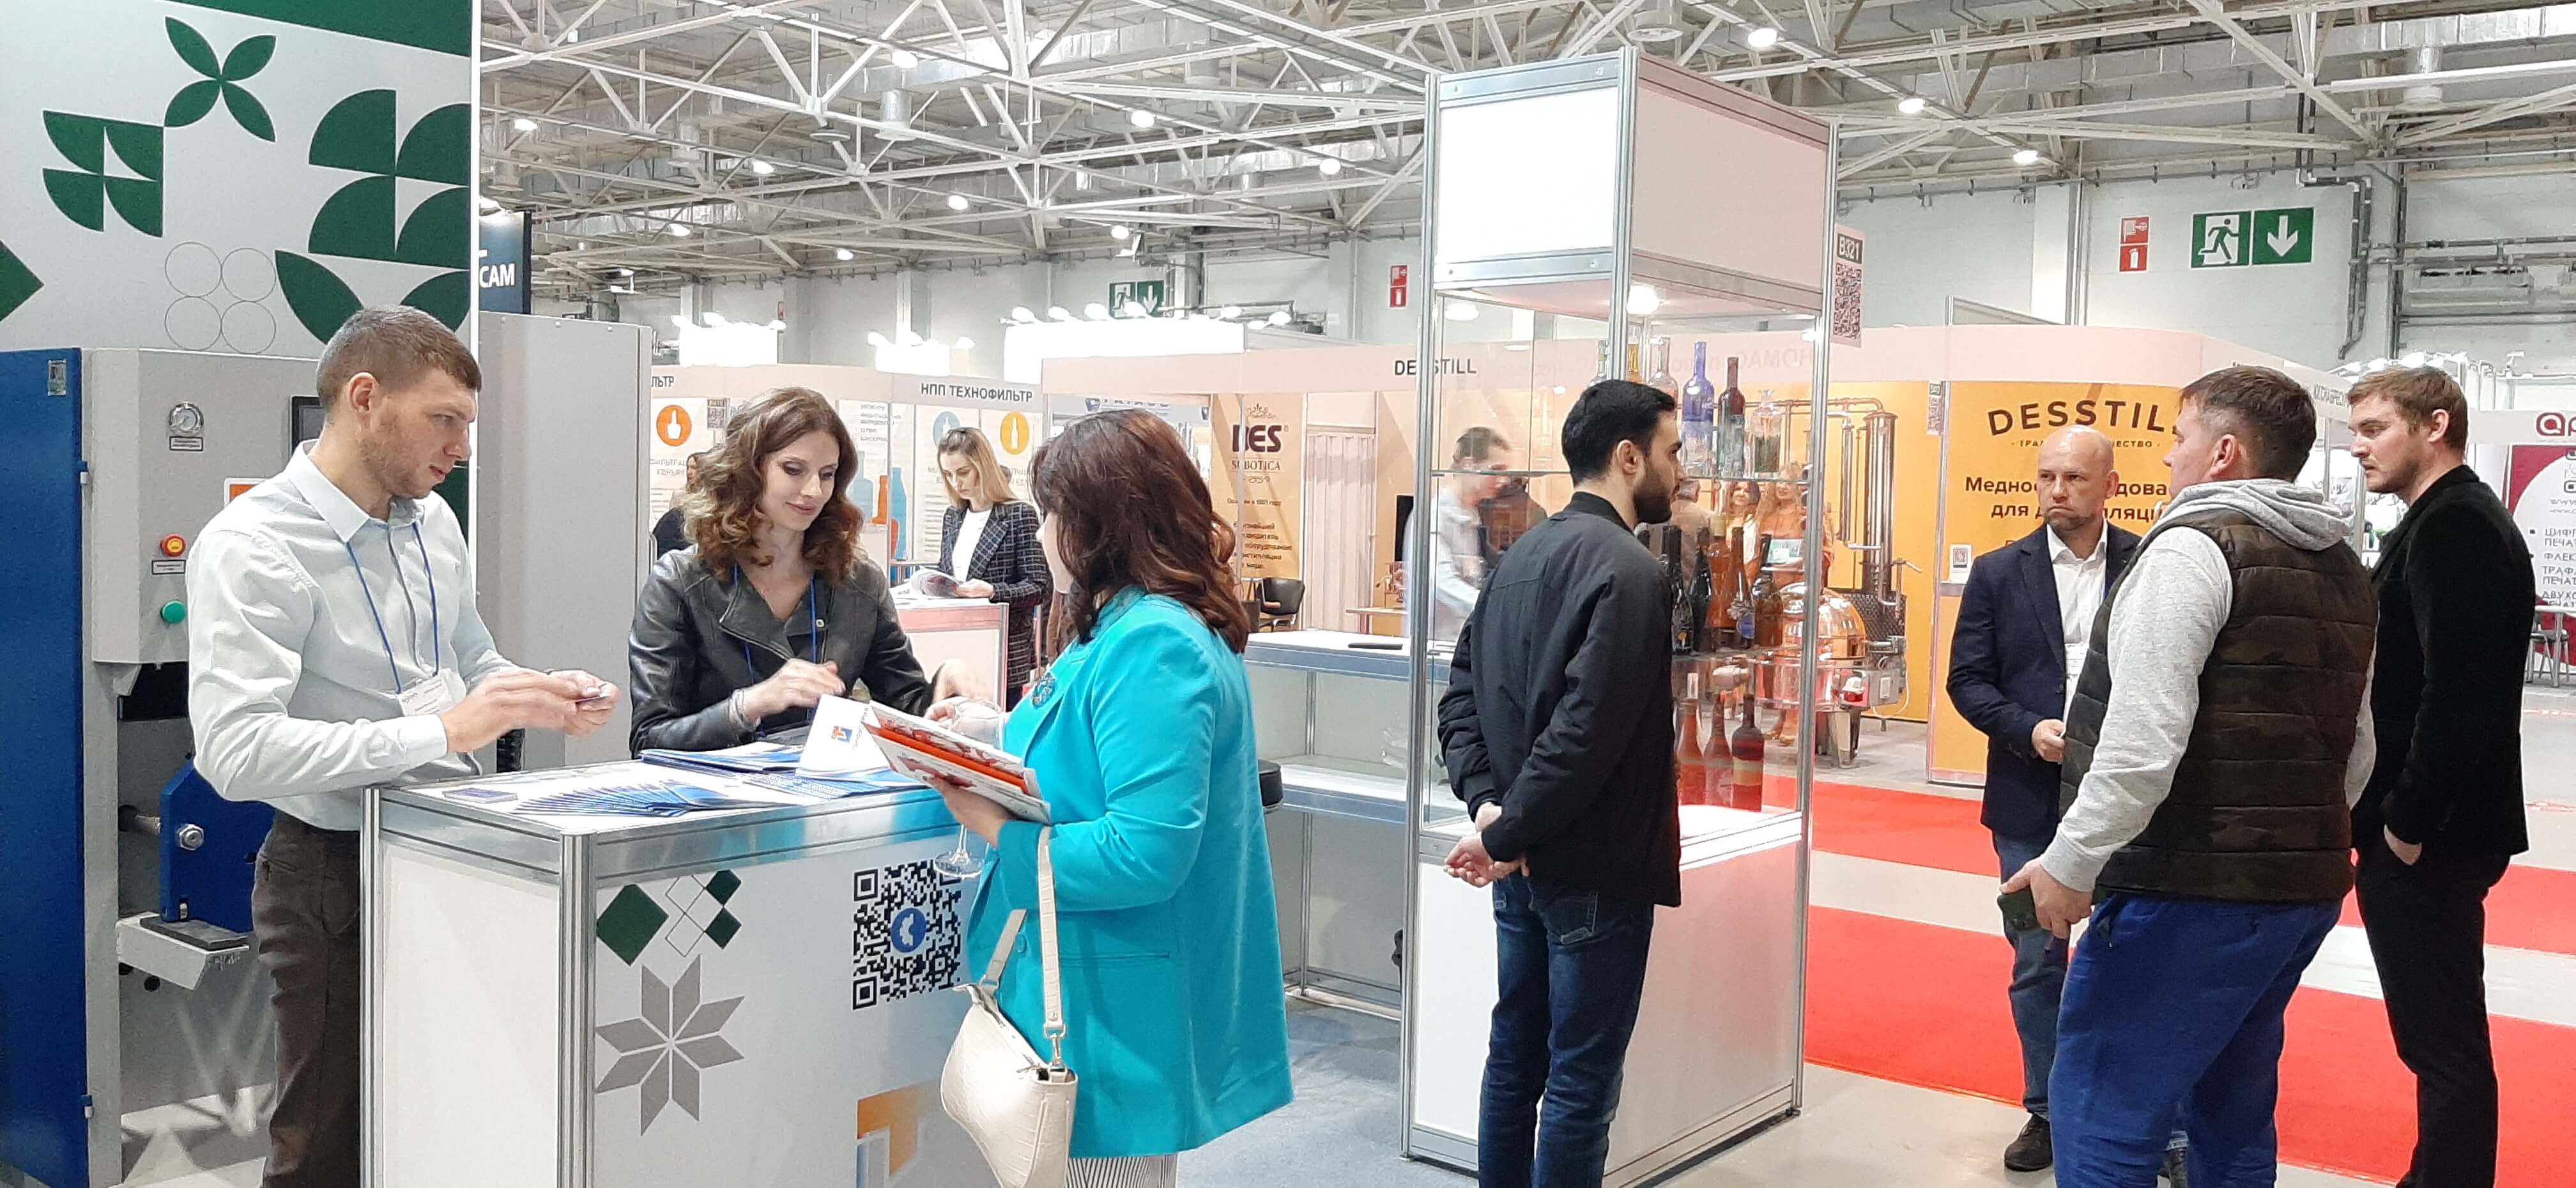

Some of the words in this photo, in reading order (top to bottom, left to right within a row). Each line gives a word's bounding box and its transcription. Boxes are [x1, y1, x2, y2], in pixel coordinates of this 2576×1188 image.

[1839, 235, 1860, 261] B321
[1395, 359, 1476, 375] DETILL
[921, 383, 946, 396] НПП
[949, 386, 1032, 402] ТЕХНОФИЛЬТР
[1988, 399, 2165, 436] DESSTIL
[1231, 460, 1281, 471] SBOTICA
[1991, 505, 2028, 519] для
[2542, 566, 2576, 575] ТРАФ
